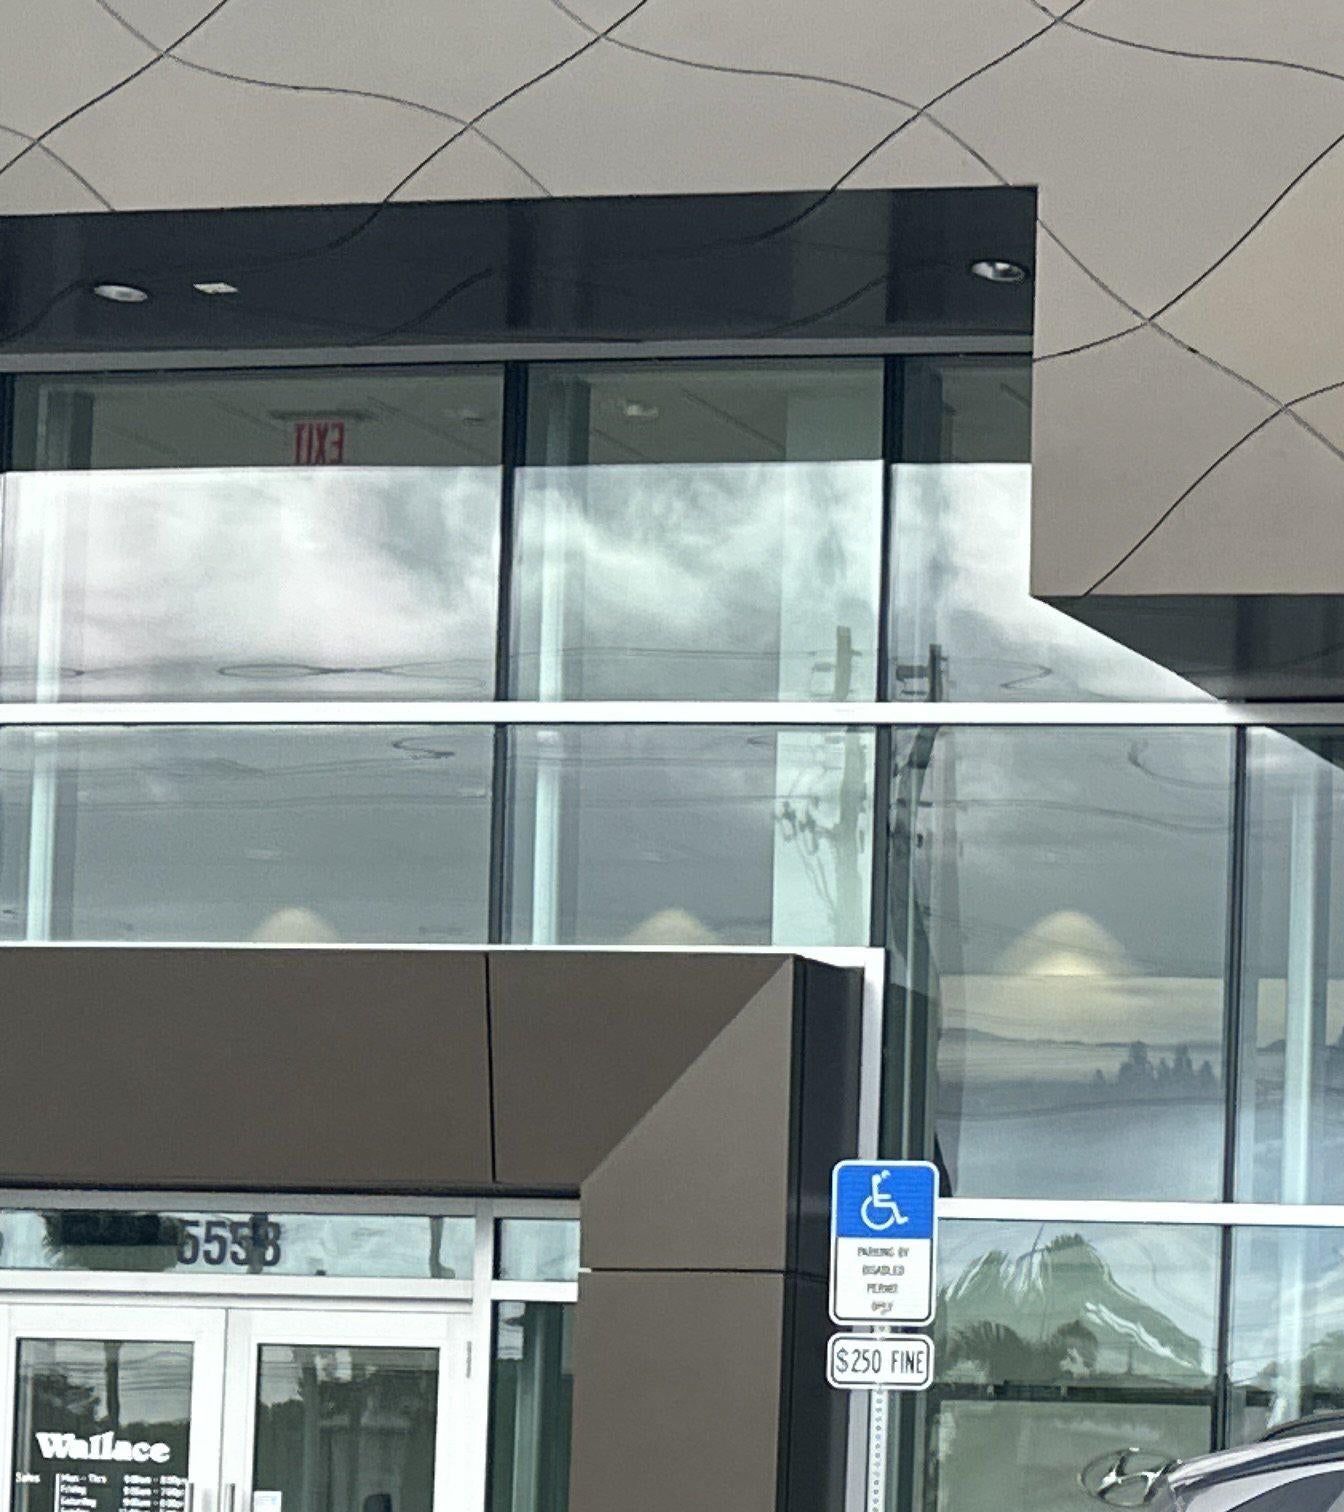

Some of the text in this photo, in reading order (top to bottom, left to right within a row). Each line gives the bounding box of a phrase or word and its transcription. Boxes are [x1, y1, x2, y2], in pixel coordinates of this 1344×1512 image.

[857, 1246, 910, 1258] PARKING BY
[862, 1264, 905, 1276] DISABLED
[836, 1347, 925, 1375] $250 FINE
[35, 1431, 171, 1463] Wallace
